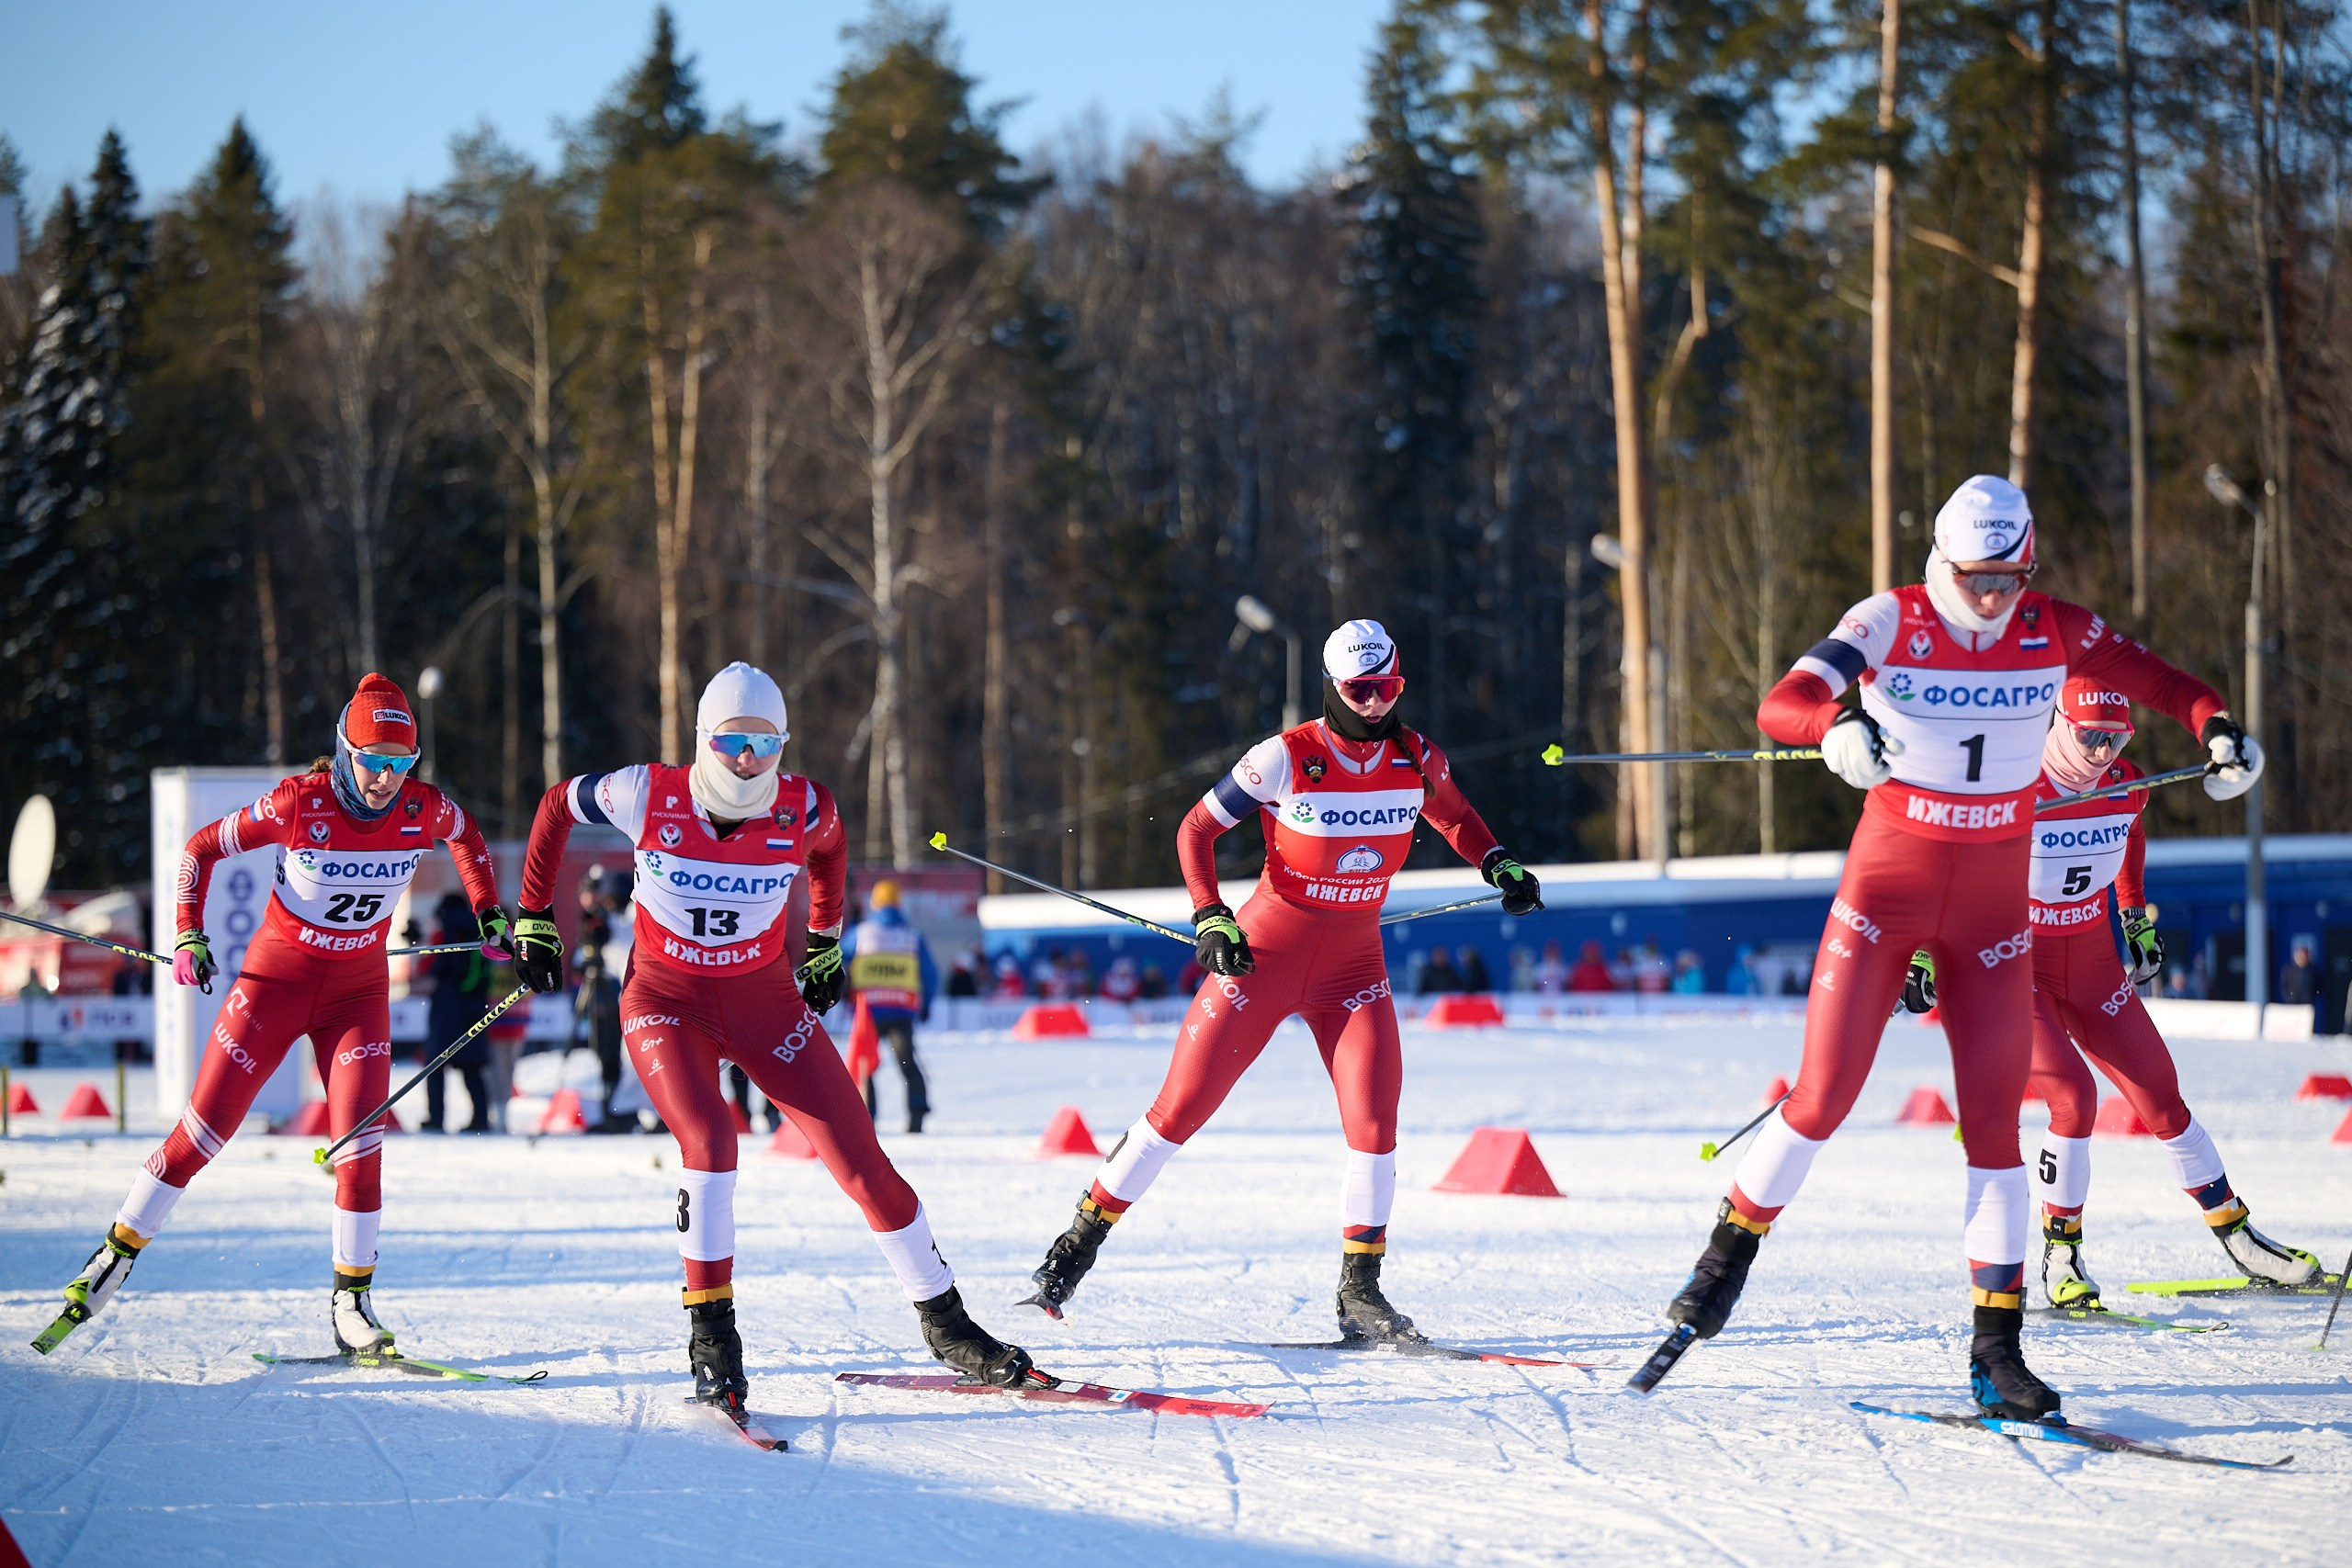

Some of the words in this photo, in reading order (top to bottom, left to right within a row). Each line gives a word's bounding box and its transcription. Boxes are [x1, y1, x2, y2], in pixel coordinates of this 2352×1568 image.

[1973, 520, 2018, 530] LUKOIL
[1349, 642, 1385, 652] LUKOIL
[1923, 682, 2054, 707] ФОСАГРО
[385, 712, 410, 723] LUKOIL
[1959, 734, 1984, 782] 1
[651, 811, 691, 819] РУСКЛИМАТ
[1320, 806, 1418, 826] ФОСАГРО
[1906, 794, 2019, 829] ИЖЕВСК
[2041, 823, 2129, 848] ФОСАГРО
[322, 853, 420, 877] ФОСАГРО
[669, 870, 795, 894] ФОСАГРО
[1306, 883, 1385, 903] ИЖЕВСК
[2062, 865, 2092, 896] 5
[324, 893, 387, 923] 25
[1829, 897, 1883, 944] LUKOIL
[2029, 898, 2102, 926] ИЖЕВСК
[684, 908, 741, 937] 13
[299, 926, 380, 951] ИЖЕВСК
[663, 936, 761, 966] ИЖЕВСК
[1214, 972, 1250, 1012] KOIL
[624, 1014, 681, 1036] LUKOIL
[214, 1022, 258, 1075] LUKOIL
[640, 1036, 664, 1053] En+
[2039, 1147, 2057, 1185] 5
[2000, 1421, 2044, 1438] salomon
